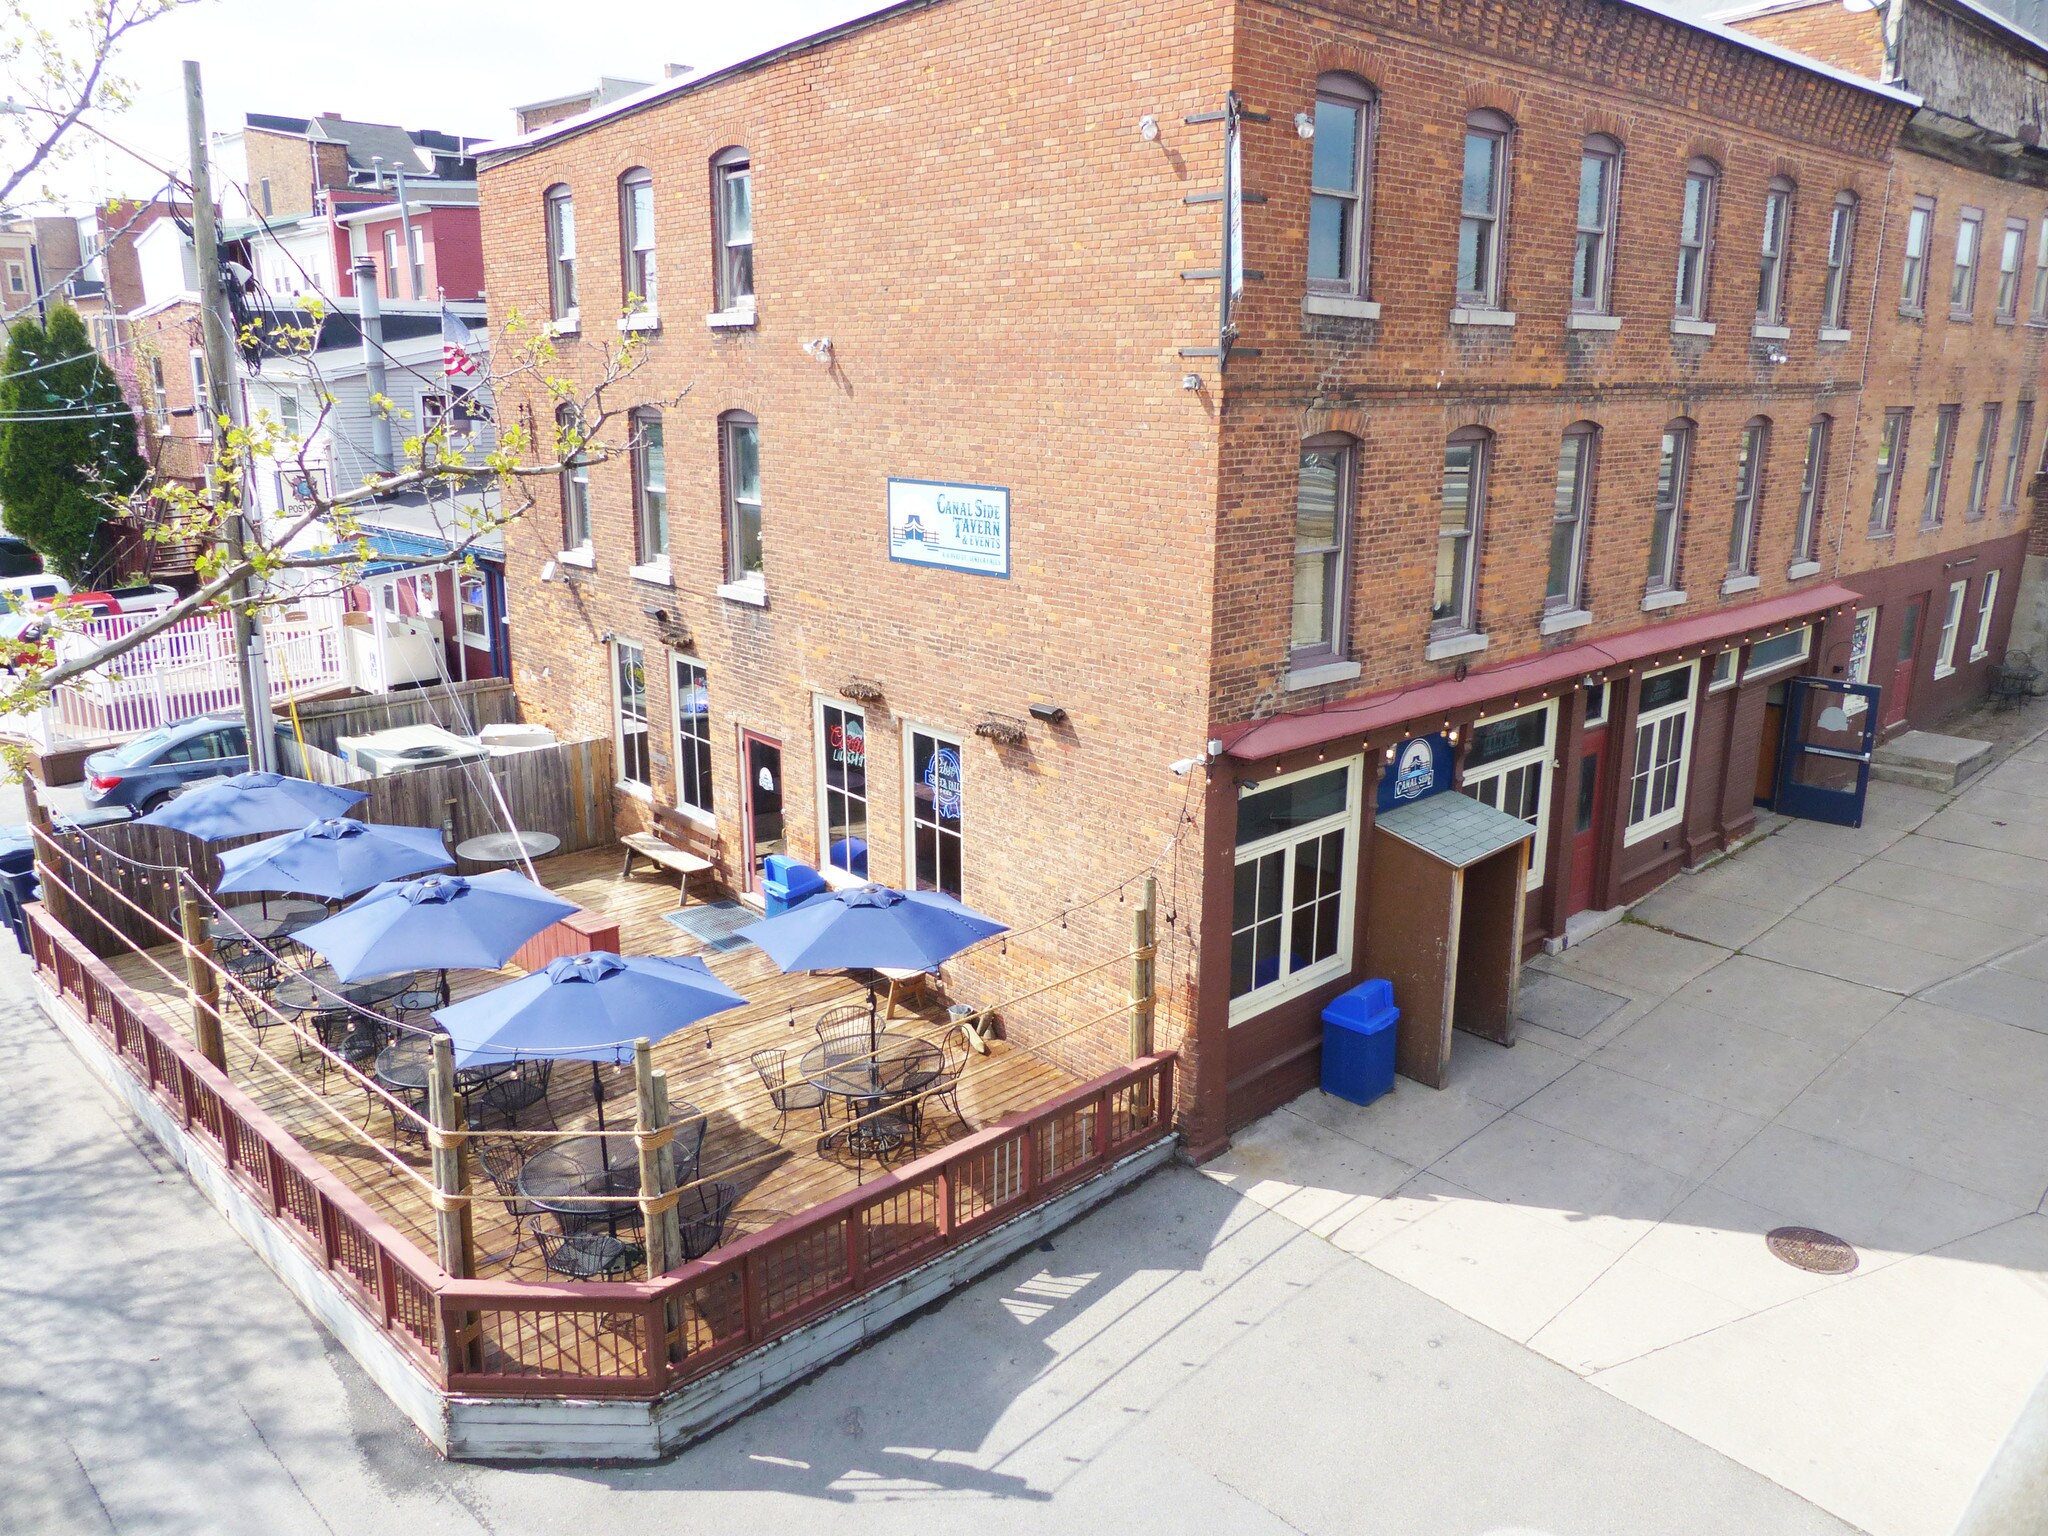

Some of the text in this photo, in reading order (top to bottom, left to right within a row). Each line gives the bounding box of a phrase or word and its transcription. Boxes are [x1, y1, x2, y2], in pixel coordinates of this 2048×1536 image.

[288, 504, 306, 514] POST
[936, 493, 1001, 520] CANAL SIDE
[953, 516, 1001, 539] TAVERN
[962, 535, 1001, 549] & EVENTS
[830, 724, 865, 755] Coor
[1397, 776, 1418, 795] CANAL
[1418, 772, 1432, 786] SIDE
